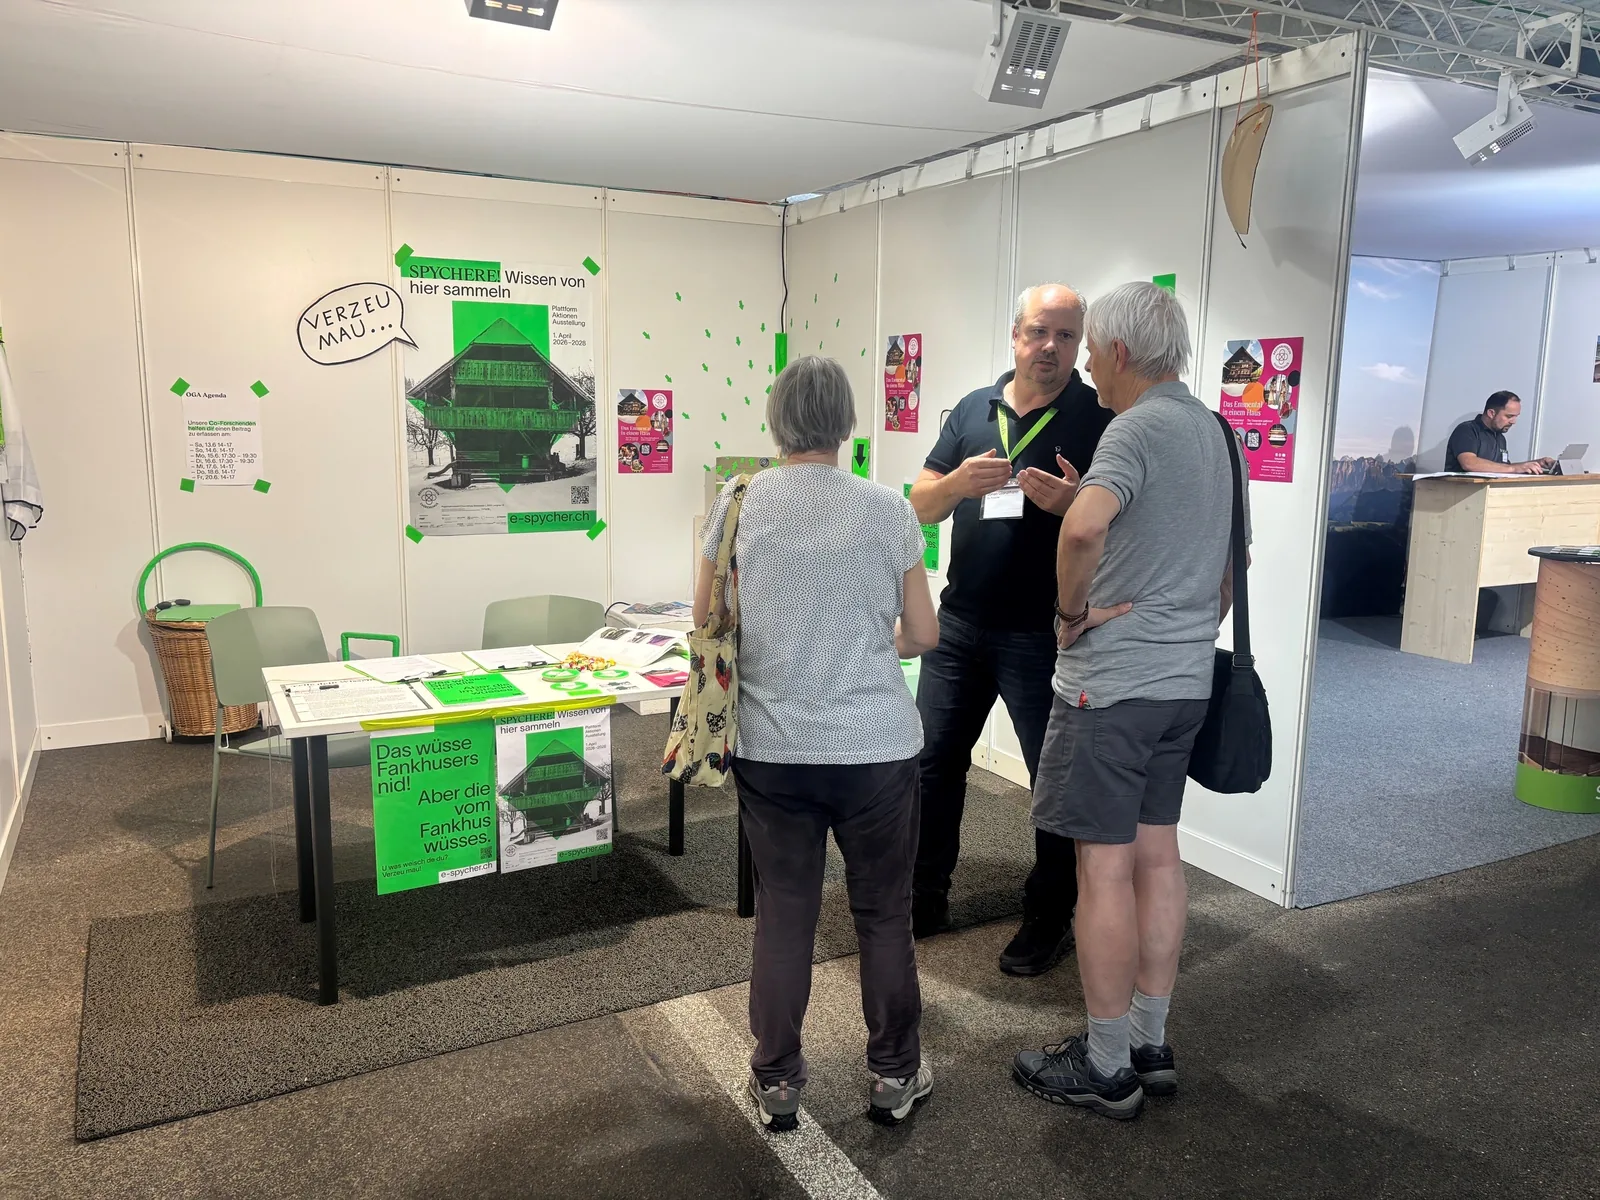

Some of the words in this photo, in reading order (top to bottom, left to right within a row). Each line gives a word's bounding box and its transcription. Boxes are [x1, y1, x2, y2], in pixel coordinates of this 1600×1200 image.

[409, 264, 501, 282] SPYCHERE!
[505, 270, 556, 286] Wissen
[560, 276, 586, 288] von
[410, 282, 440, 295] hier
[443, 284, 511, 298] sammeln
[304, 291, 390, 329] VERZEU
[319, 319, 393, 350] MAU...
[510, 510, 590, 525] e-spycher.ch
[500, 711, 555, 725] SPYCHERE!
[557, 708, 588, 718] Wissen
[500, 726, 518, 734] hier
[520, 720, 560, 732] sammeln
[376, 744, 412, 760] Das
[416, 738, 472, 756] wüsse
[377, 752, 479, 777] Fankhusers
[378, 775, 411, 794] nid!
[418, 786, 460, 806] Aber
[464, 782, 490, 798] die
[454, 801, 490, 816] vom
[420, 815, 491, 838] Fankhus
[424, 834, 491, 854] wüsses.
[559, 843, 608, 858] e-spycher.ch
[402, 859, 425, 868] weisch
[440, 862, 492, 878] e-spycher.ch
